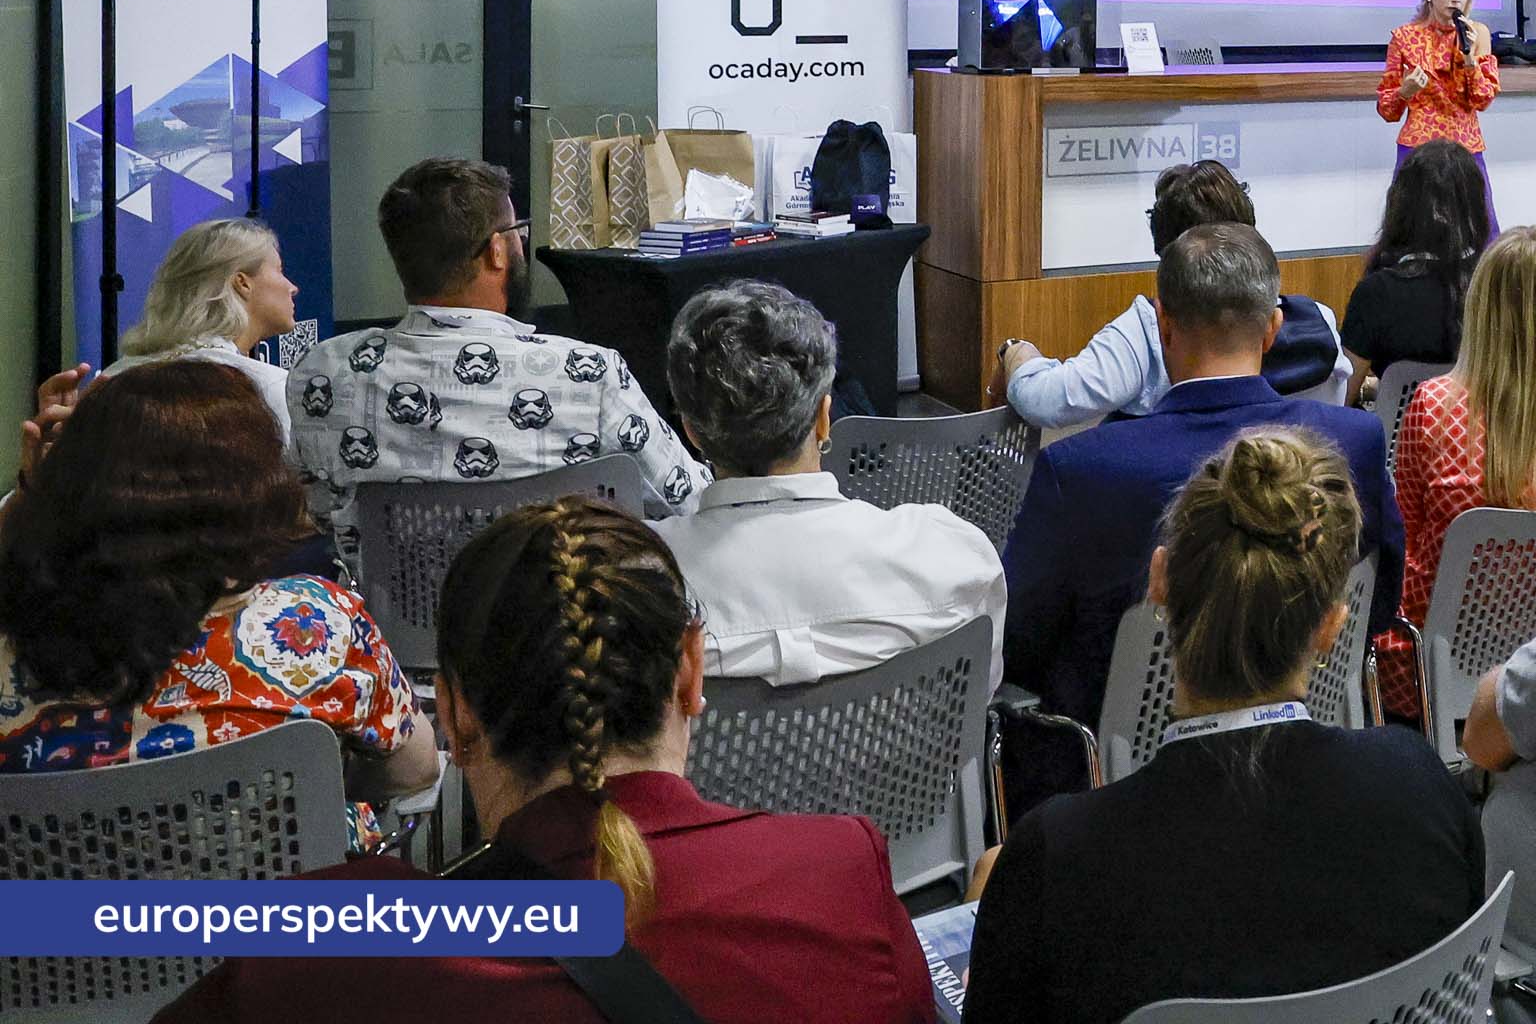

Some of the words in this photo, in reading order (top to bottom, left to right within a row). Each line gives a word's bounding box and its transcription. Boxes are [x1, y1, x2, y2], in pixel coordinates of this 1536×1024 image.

[708, 57, 865, 83] ocaday.com
[1058, 134, 1186, 163] ŻELIWNA
[1200, 134, 1236, 160] 38
[1177, 720, 1219, 736] Katowice
